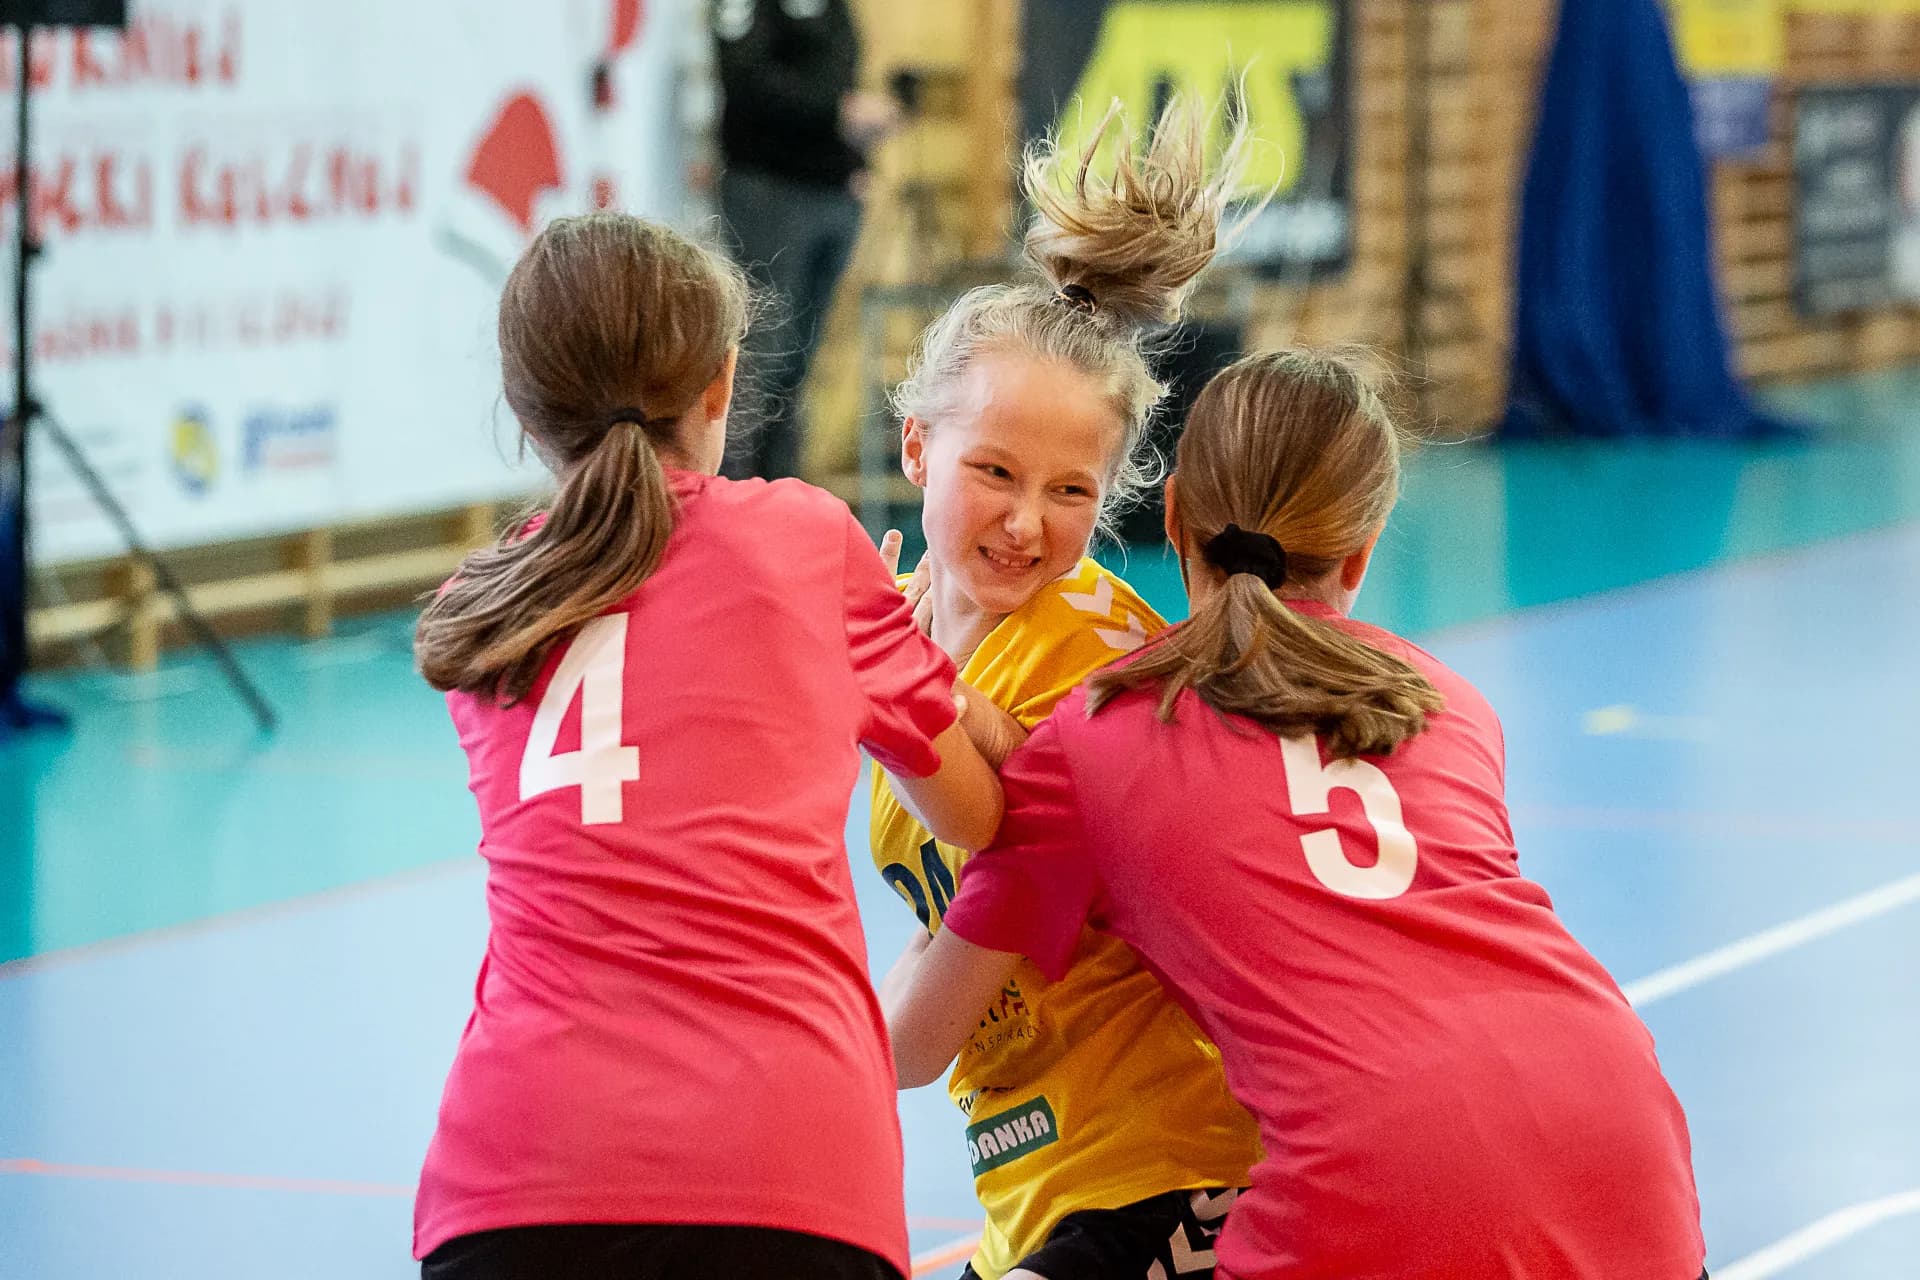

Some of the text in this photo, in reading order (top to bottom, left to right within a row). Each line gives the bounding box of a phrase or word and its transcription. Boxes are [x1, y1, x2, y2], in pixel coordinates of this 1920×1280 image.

[519, 612, 640, 825] 4
[1280, 733, 1418, 900] 5
[968, 1110, 1050, 1166] DANKA
